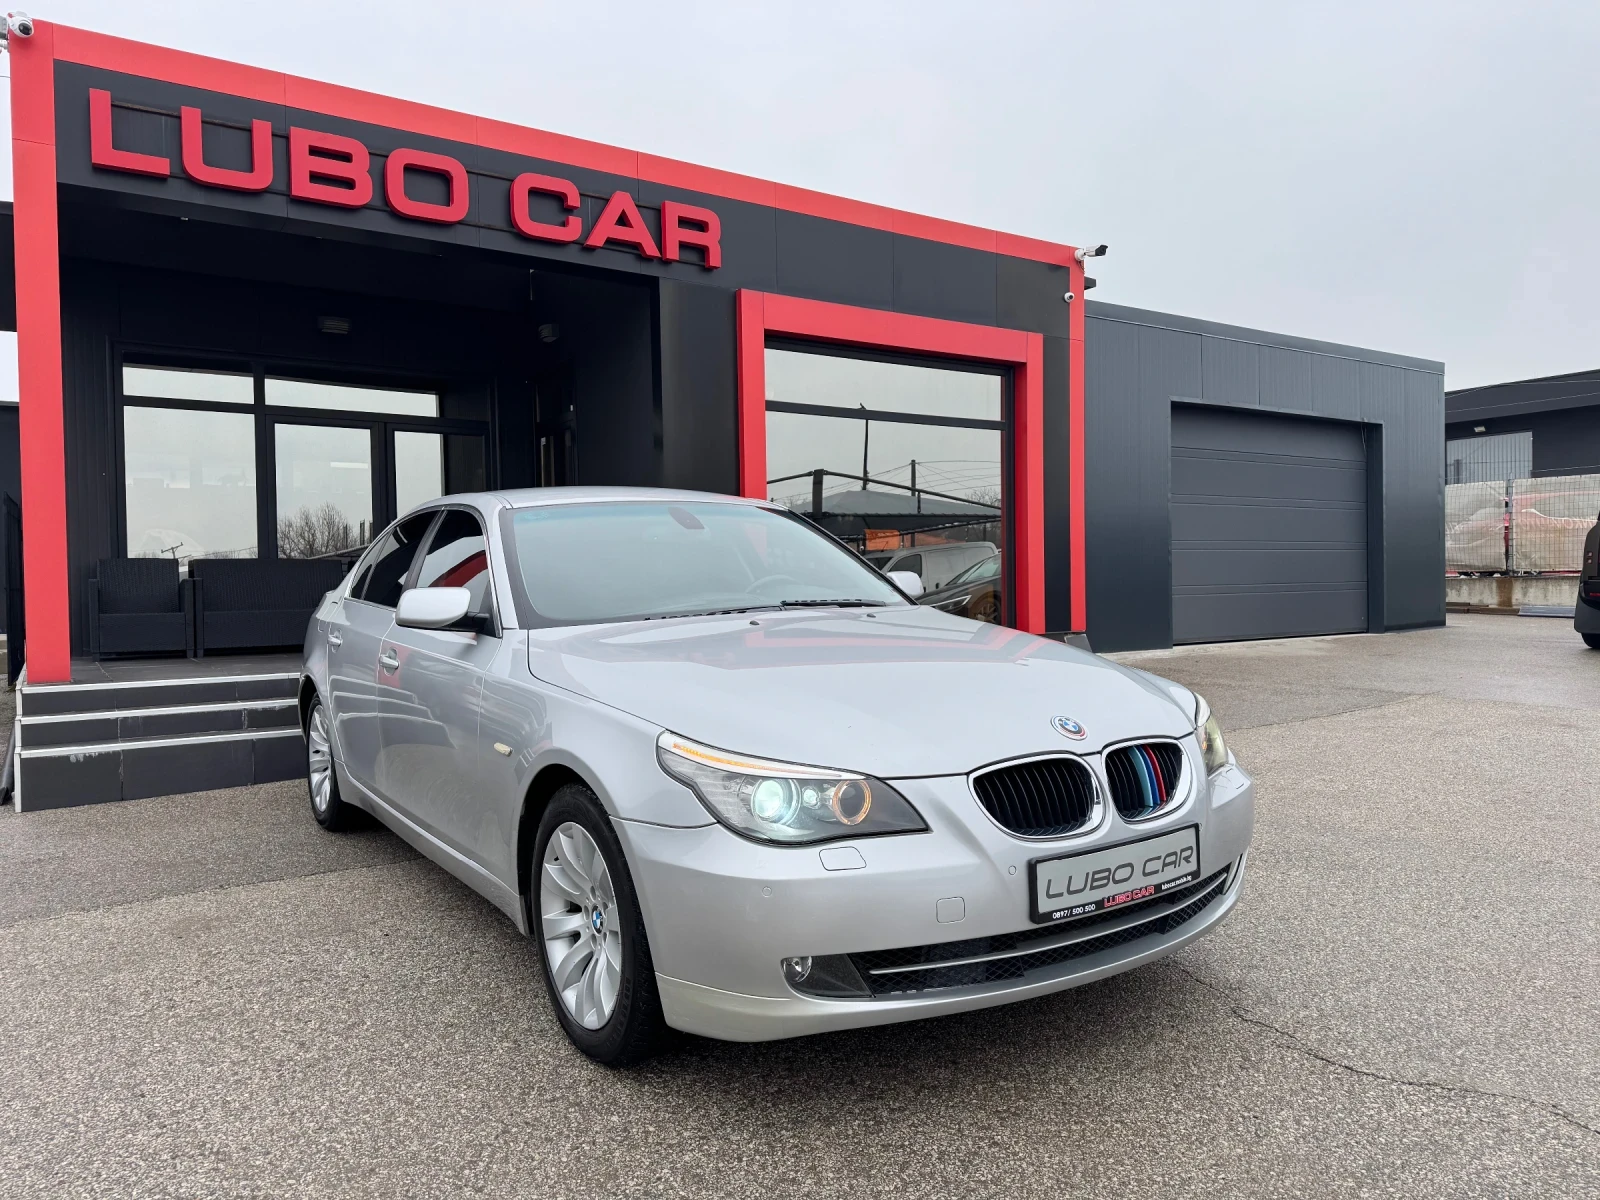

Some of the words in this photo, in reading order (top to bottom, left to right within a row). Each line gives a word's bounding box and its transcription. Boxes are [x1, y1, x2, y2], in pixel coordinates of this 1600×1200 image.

[89, 87, 469, 225] LUBO
[509, 173, 722, 270] CAR
[1045, 862, 1135, 900] LUBO
[1141, 845, 1194, 876] CAR
[1072, 906, 1084, 915] 500
[1084, 903, 1096, 912] 500
[1102, 891, 1132, 908] LUBO
[1132, 884, 1155, 900] CAR
